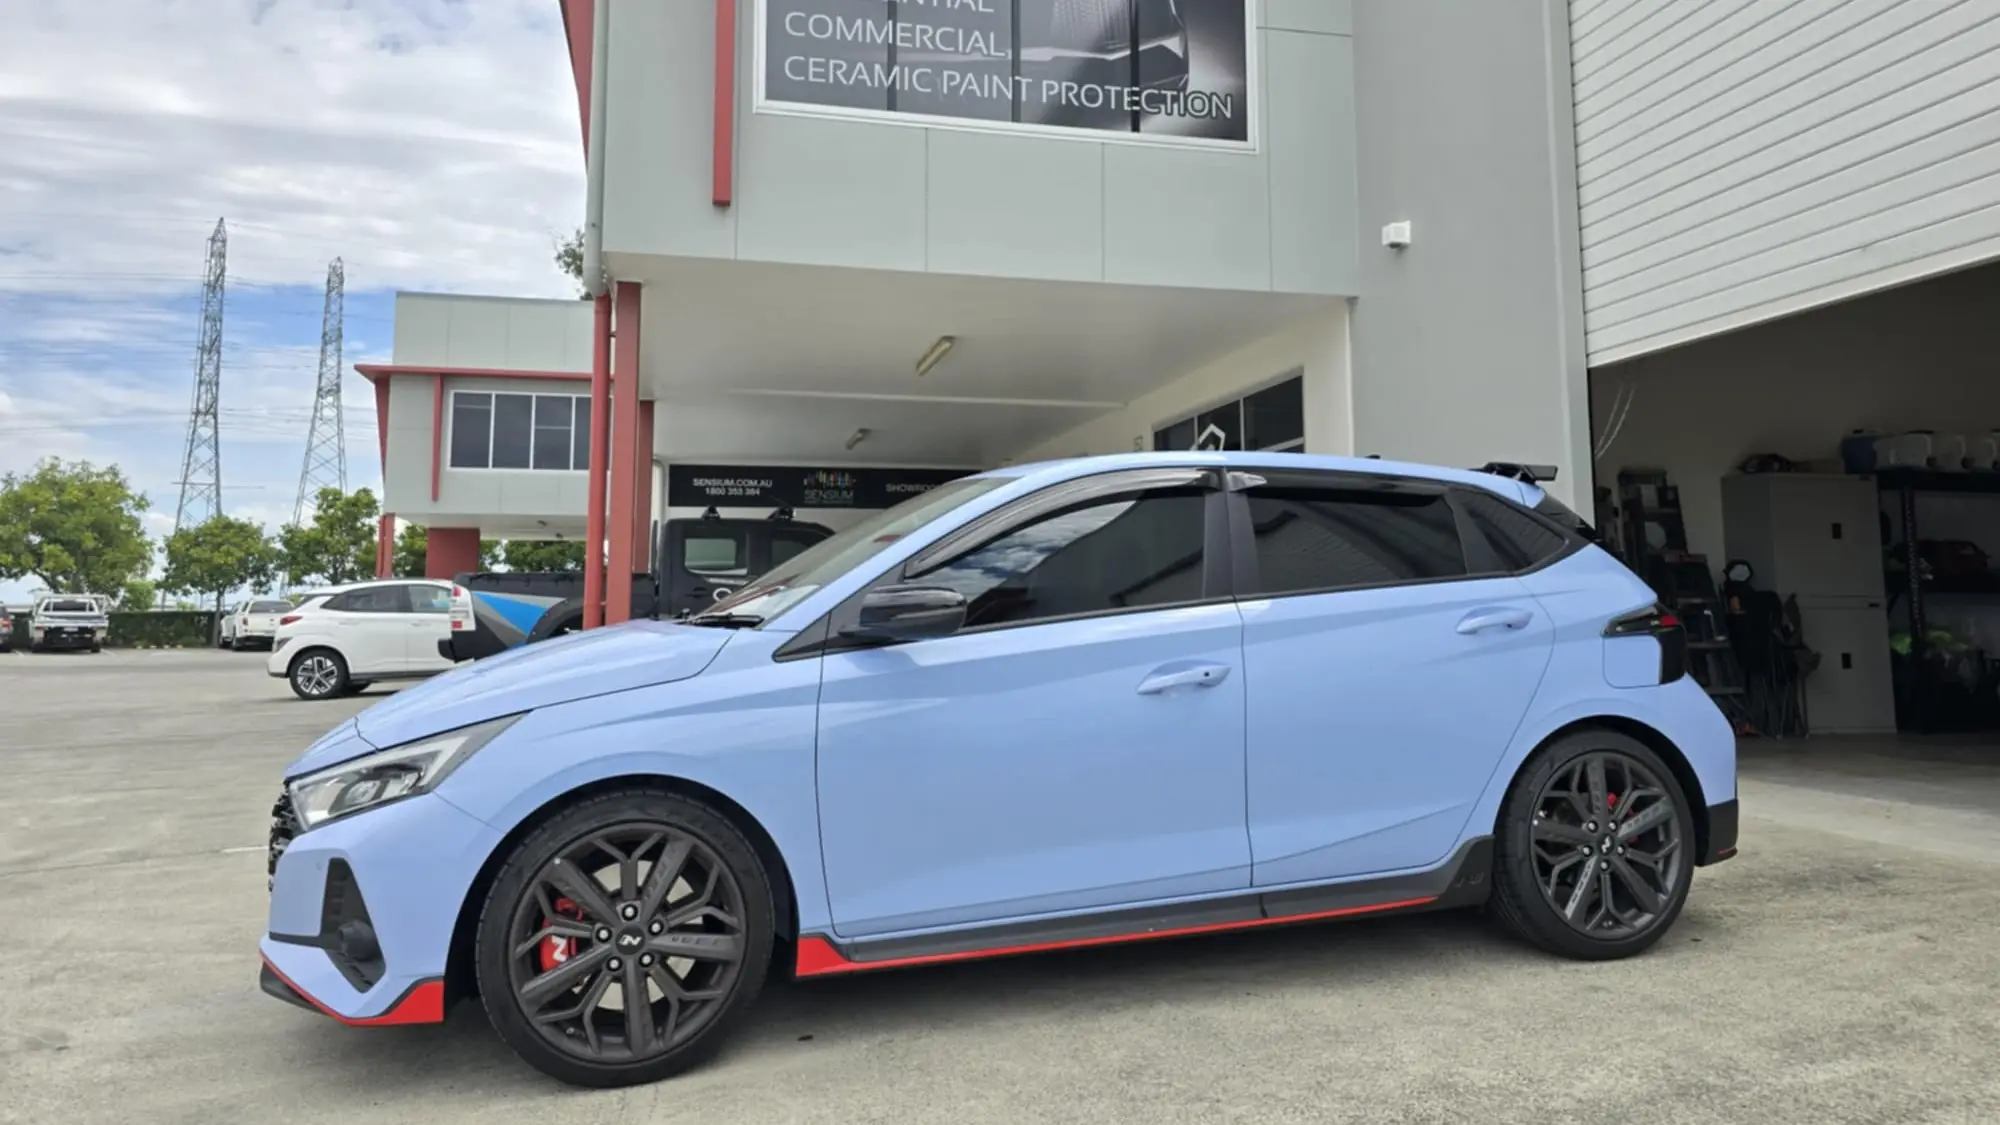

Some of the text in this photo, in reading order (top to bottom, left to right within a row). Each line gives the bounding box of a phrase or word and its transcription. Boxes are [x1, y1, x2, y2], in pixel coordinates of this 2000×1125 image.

[784, 11, 1006, 57] COMMERCIAL
[784, 55, 1232, 118] CERAMIC PAINT PROTECTION
[705, 486, 726, 496] 1800
[804, 489, 854, 500] SENSIUM
